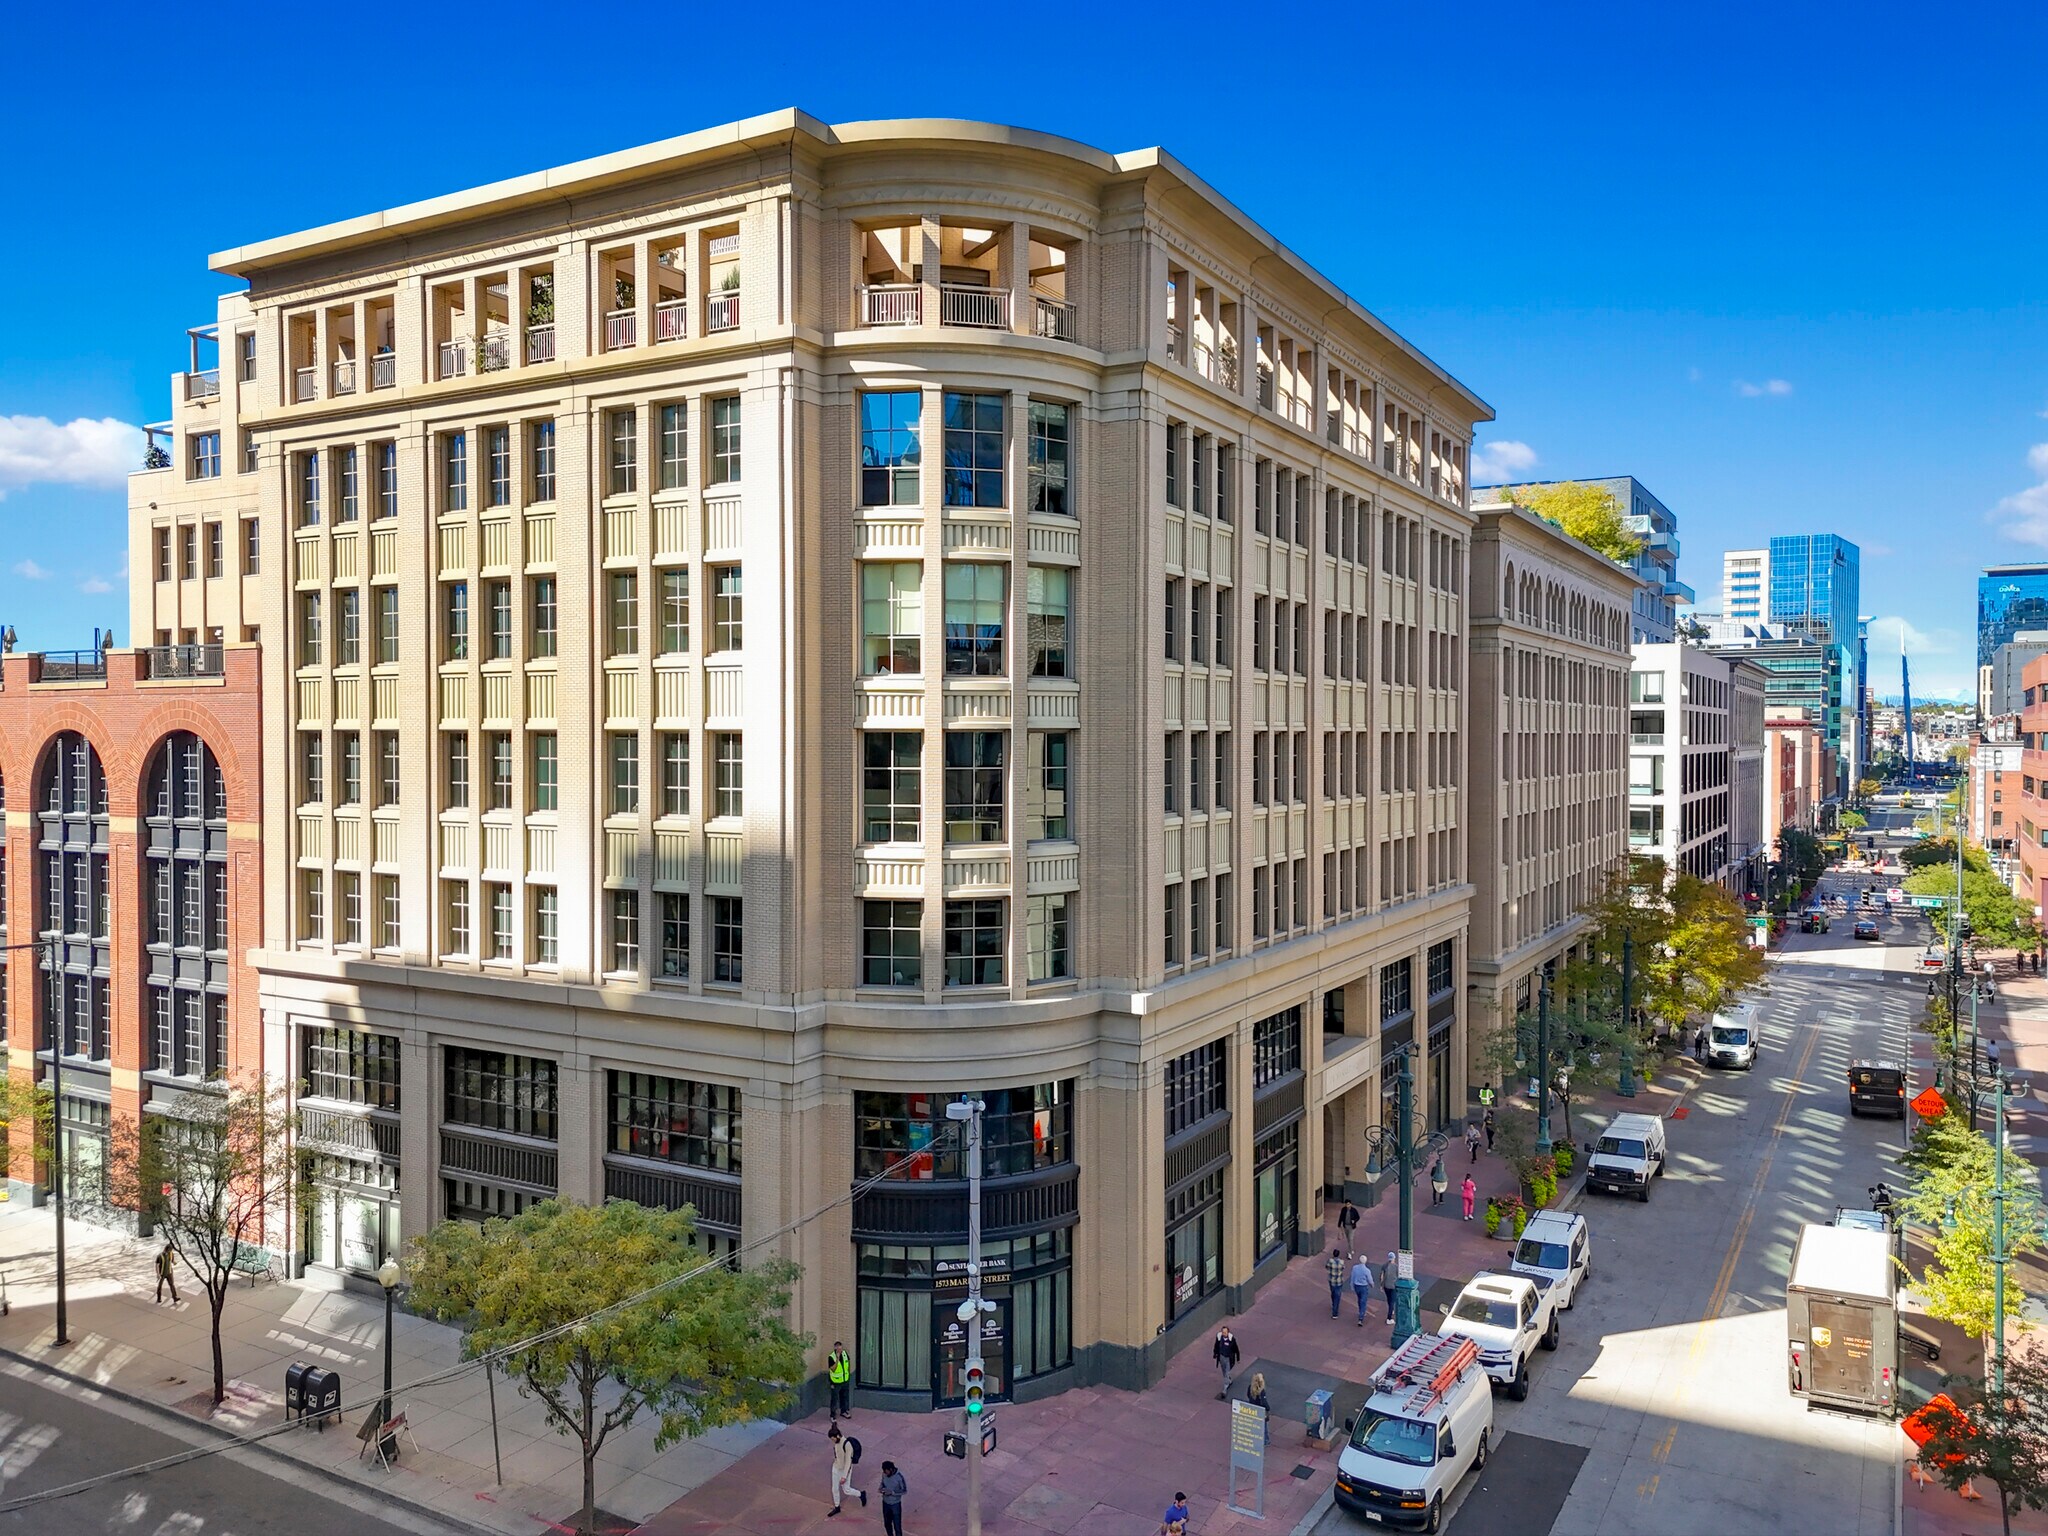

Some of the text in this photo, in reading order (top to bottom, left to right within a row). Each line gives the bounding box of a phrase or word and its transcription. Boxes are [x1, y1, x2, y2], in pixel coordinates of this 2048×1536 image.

[1999, 584, 2020, 592] DaVita
[1918, 1099, 1944, 1108] DETOUR
[989, 1259, 1006, 1267] BANK
[935, 1280, 949, 1288] 1573
[984, 1274, 1011, 1283] STREET
[1182, 1286, 1194, 1302] BANK
